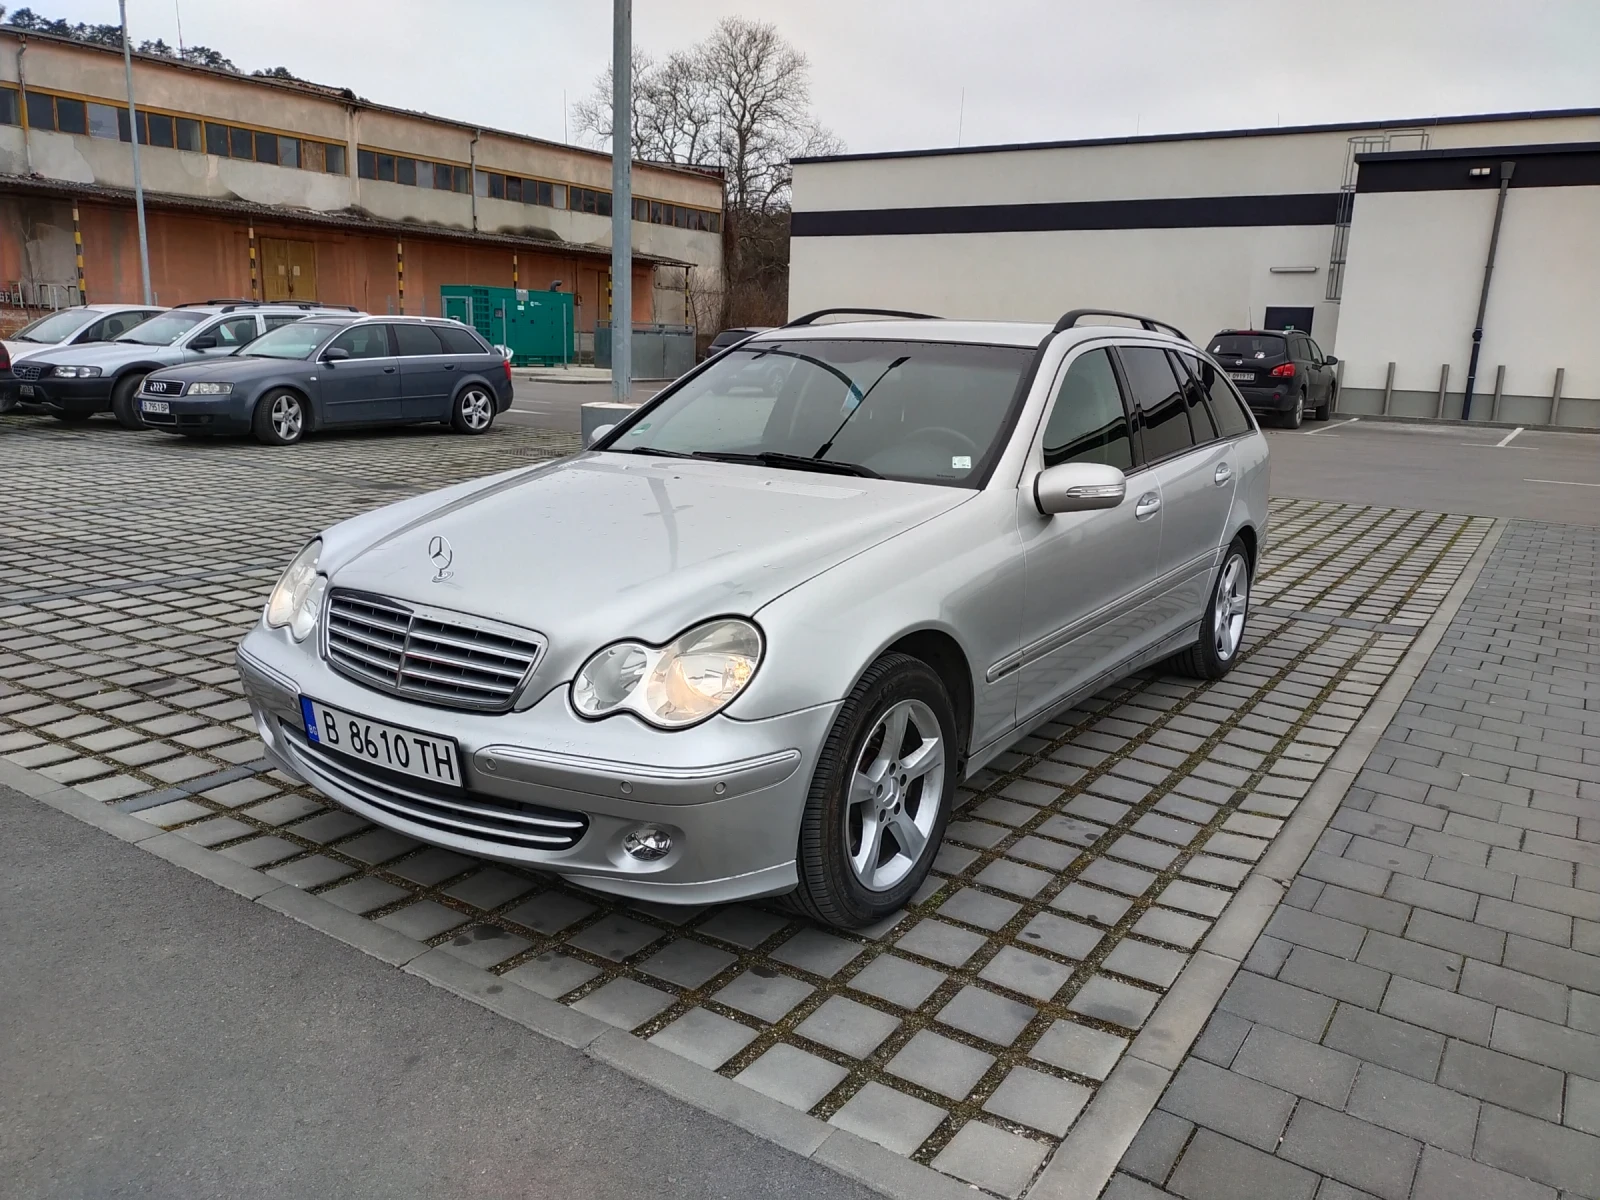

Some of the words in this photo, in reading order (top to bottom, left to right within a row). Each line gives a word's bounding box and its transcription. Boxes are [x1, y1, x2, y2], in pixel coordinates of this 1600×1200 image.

[307, 723, 319, 737] BG
[322, 709, 340, 745] B
[348, 720, 411, 769] 8610
[413, 738, 455, 781] TH
